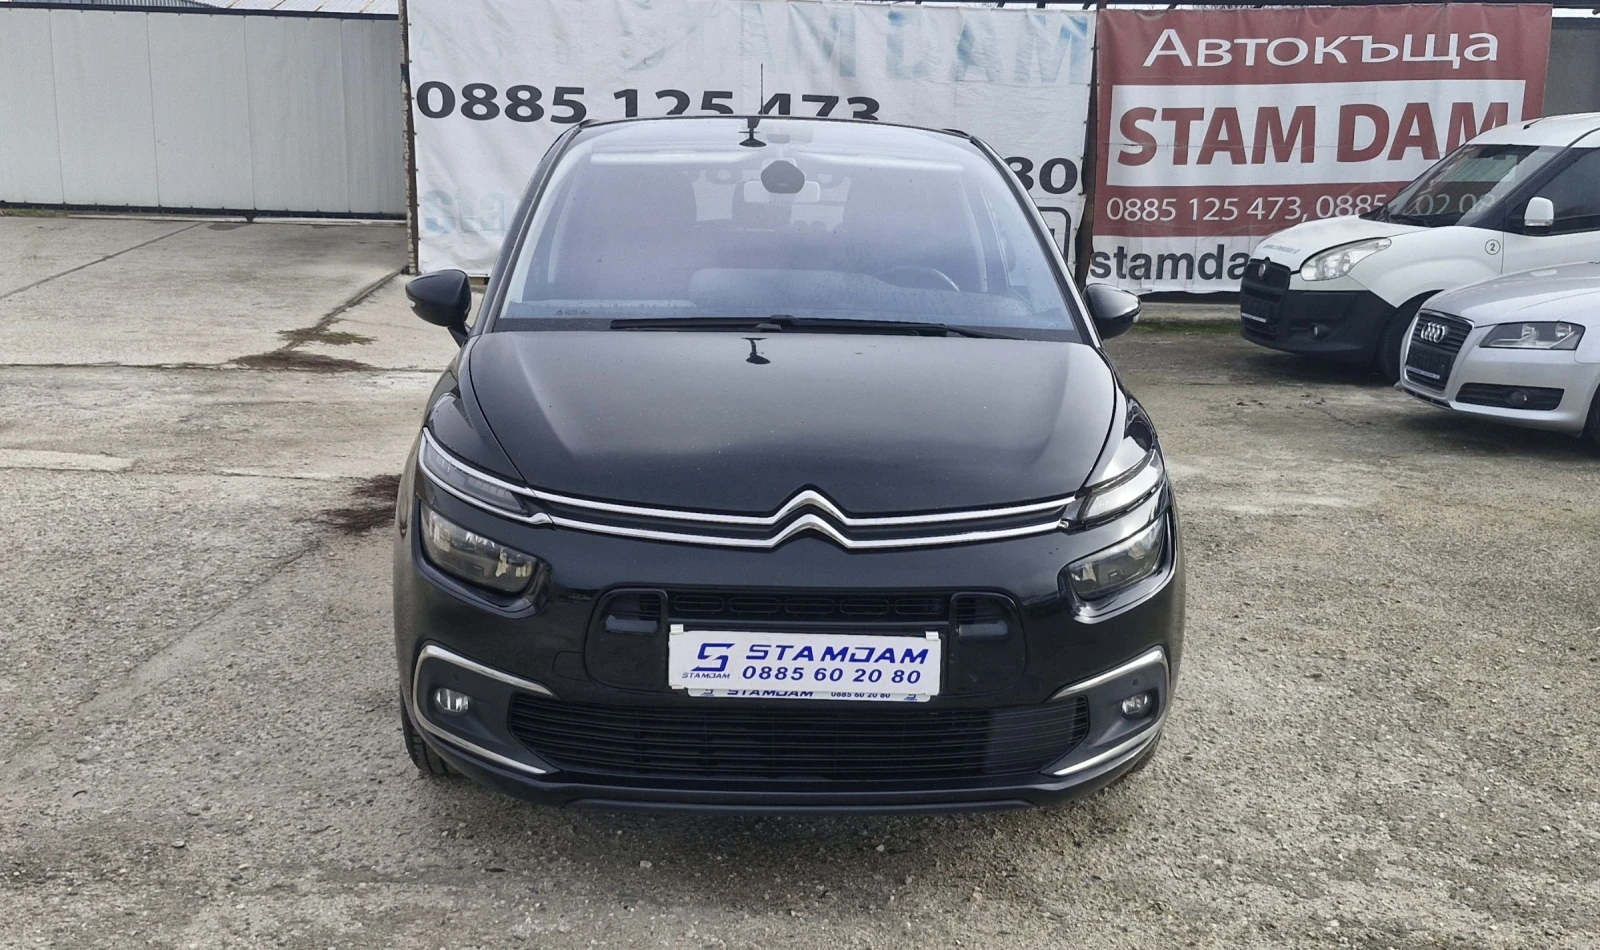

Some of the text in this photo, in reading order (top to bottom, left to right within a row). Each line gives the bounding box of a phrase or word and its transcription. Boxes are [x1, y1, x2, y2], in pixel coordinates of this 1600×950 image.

[1143, 28, 1499, 69] Автокъща
[416, 80, 880, 124] 0885 125 473
[1117, 102, 1509, 167] STAM DAM
[1106, 197, 1177, 222] 0885
[1188, 197, 1239, 221] 125
[1246, 196, 1308, 222] 473,
[745, 643, 929, 665] STAMDAM
[742, 665, 921, 684] 0885 60 20 80
